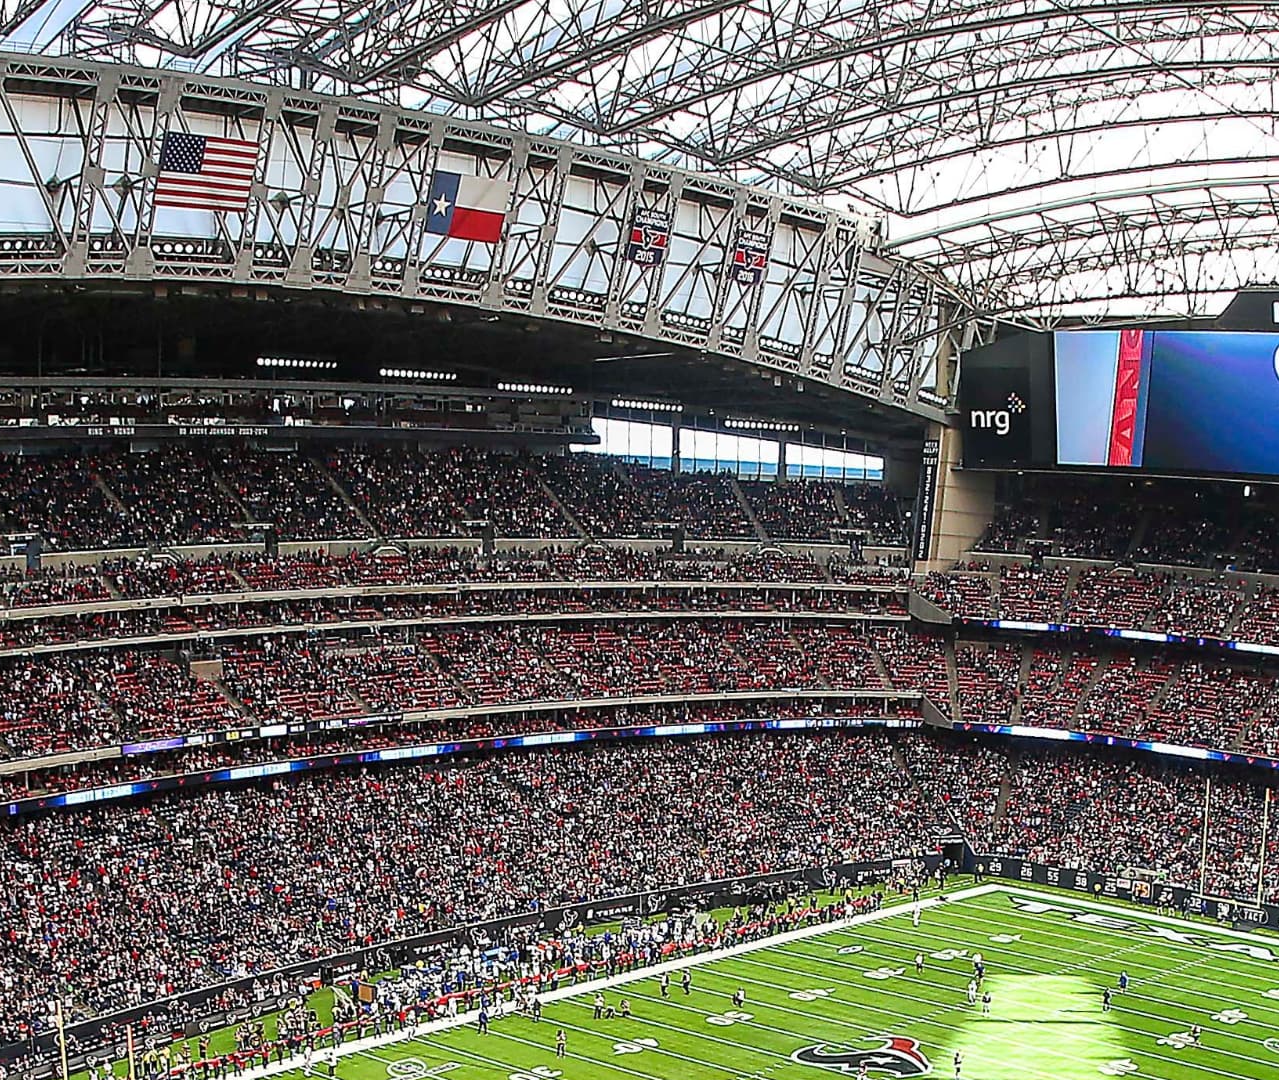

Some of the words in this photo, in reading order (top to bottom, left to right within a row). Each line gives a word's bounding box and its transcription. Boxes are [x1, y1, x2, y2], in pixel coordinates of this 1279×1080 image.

[635, 250, 655, 263] 2015
[971, 410, 1010, 435] nrg
[989, 862, 1002, 872] 29
[1021, 866, 1033, 878] 26
[1047, 871, 1060, 882] 55
[1104, 881, 1118, 893] 25
